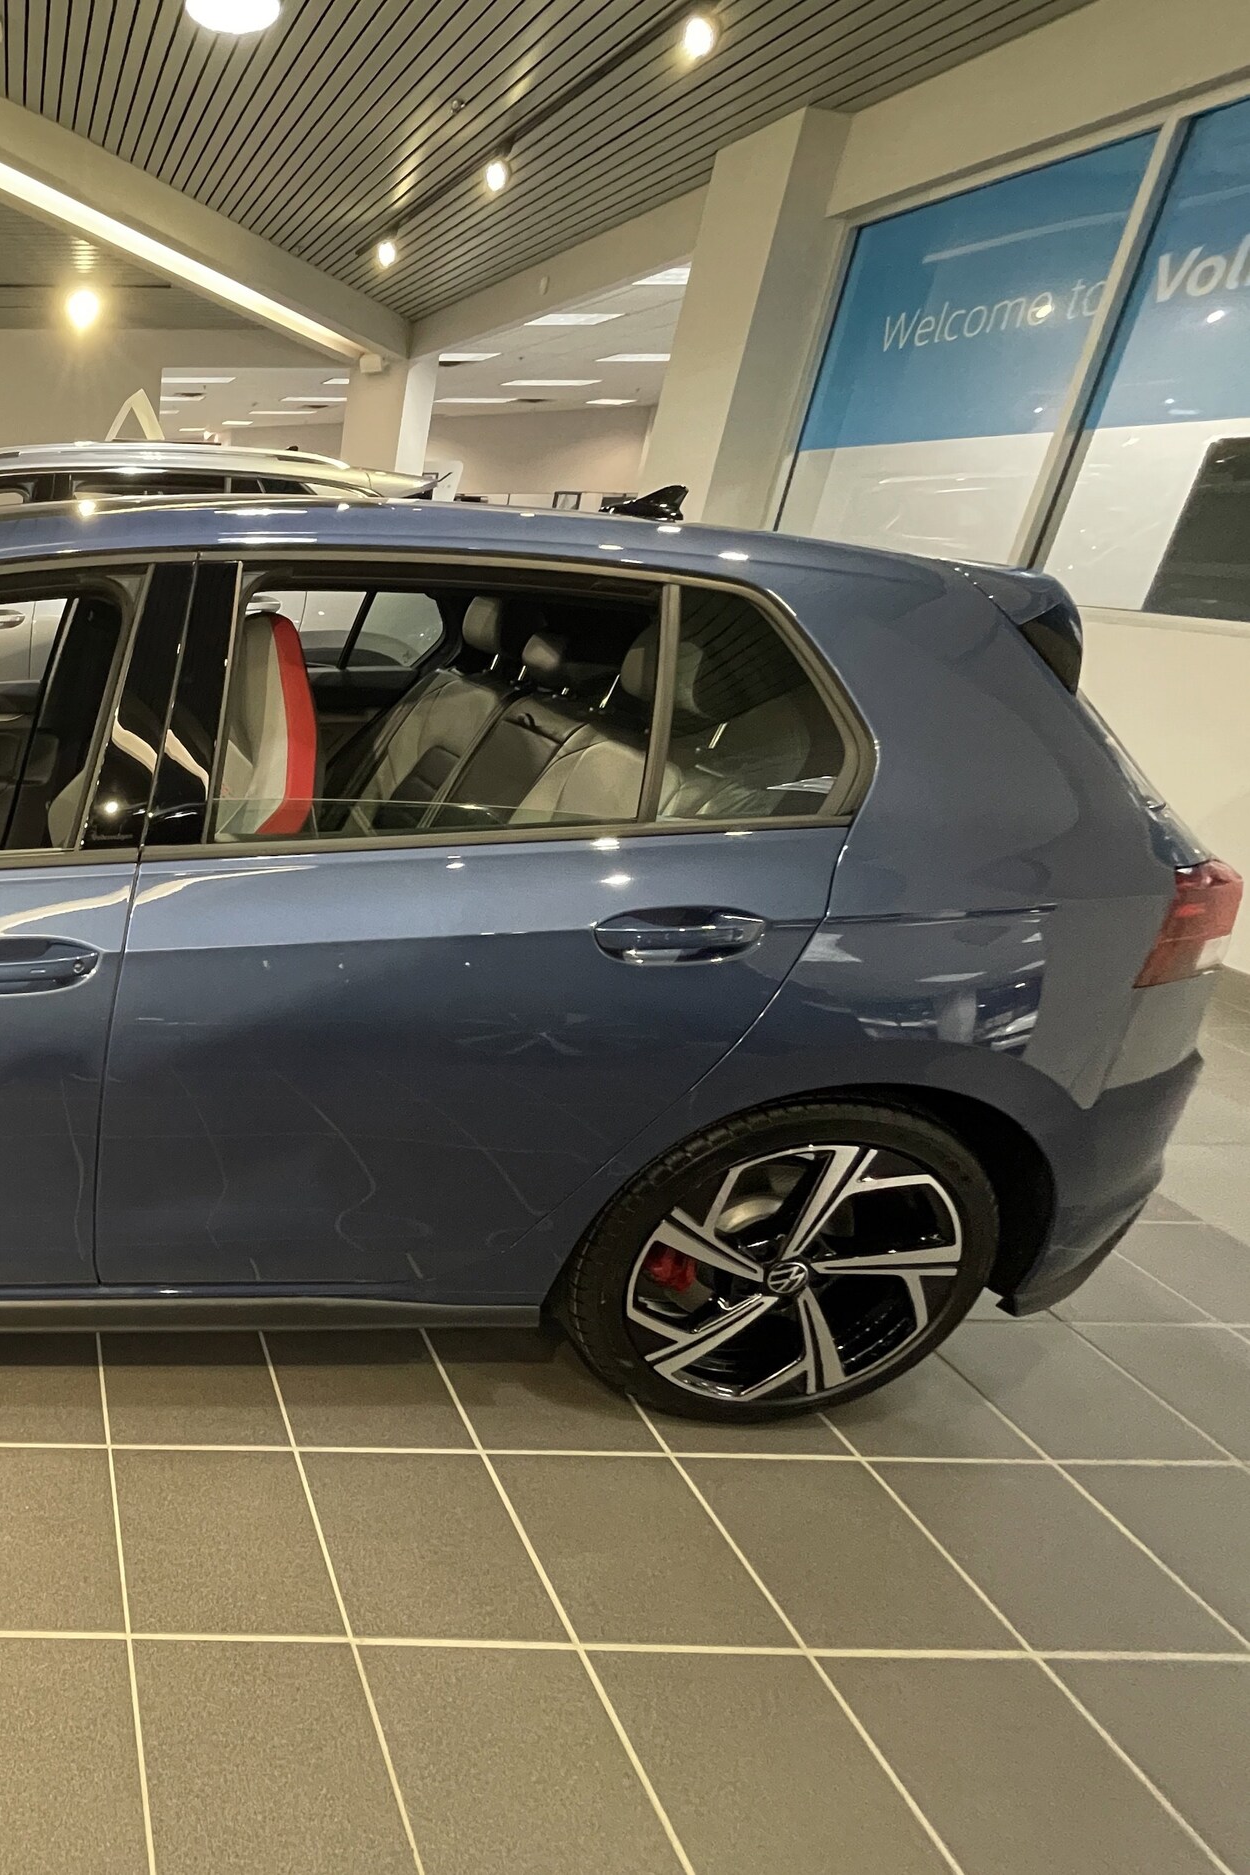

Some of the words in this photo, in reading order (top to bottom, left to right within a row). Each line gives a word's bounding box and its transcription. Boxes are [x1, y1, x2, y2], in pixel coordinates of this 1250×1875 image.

[882, 291, 1054, 353] Welcome
[1066, 278, 1108, 320] to
[1155, 232, 1250, 304] Vol
